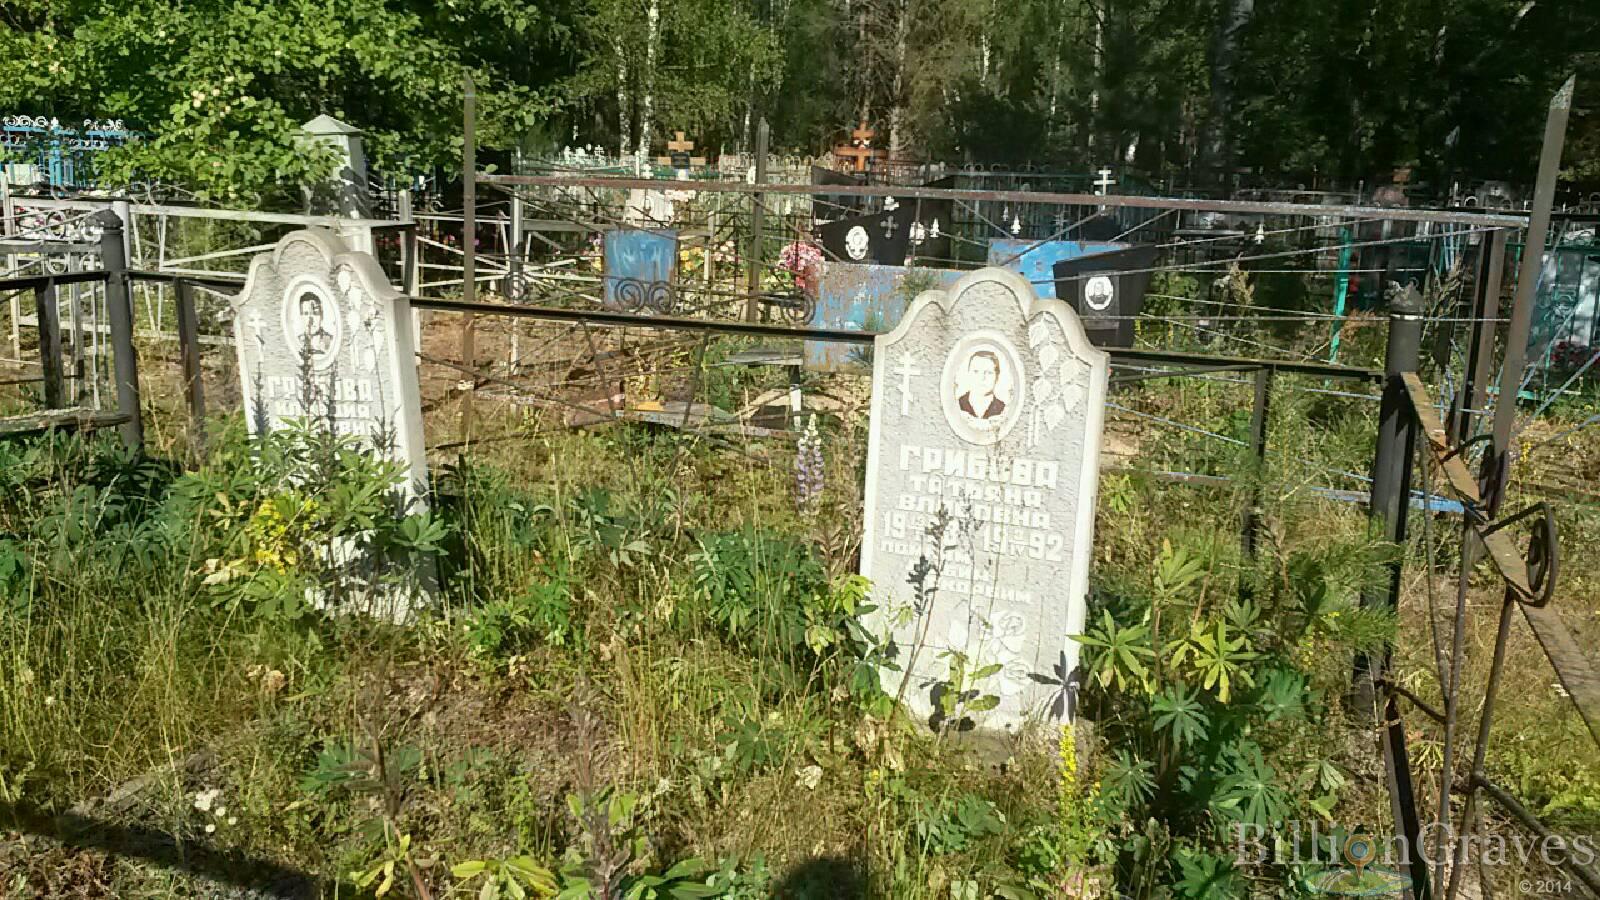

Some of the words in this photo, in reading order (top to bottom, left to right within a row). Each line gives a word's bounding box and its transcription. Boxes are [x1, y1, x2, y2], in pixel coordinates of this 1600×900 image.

[266, 375, 372, 401] ГРОВА
[275, 401, 371, 418] КЛАВИЯ
[908, 473, 1042, 508] ТАТЬЯНА
